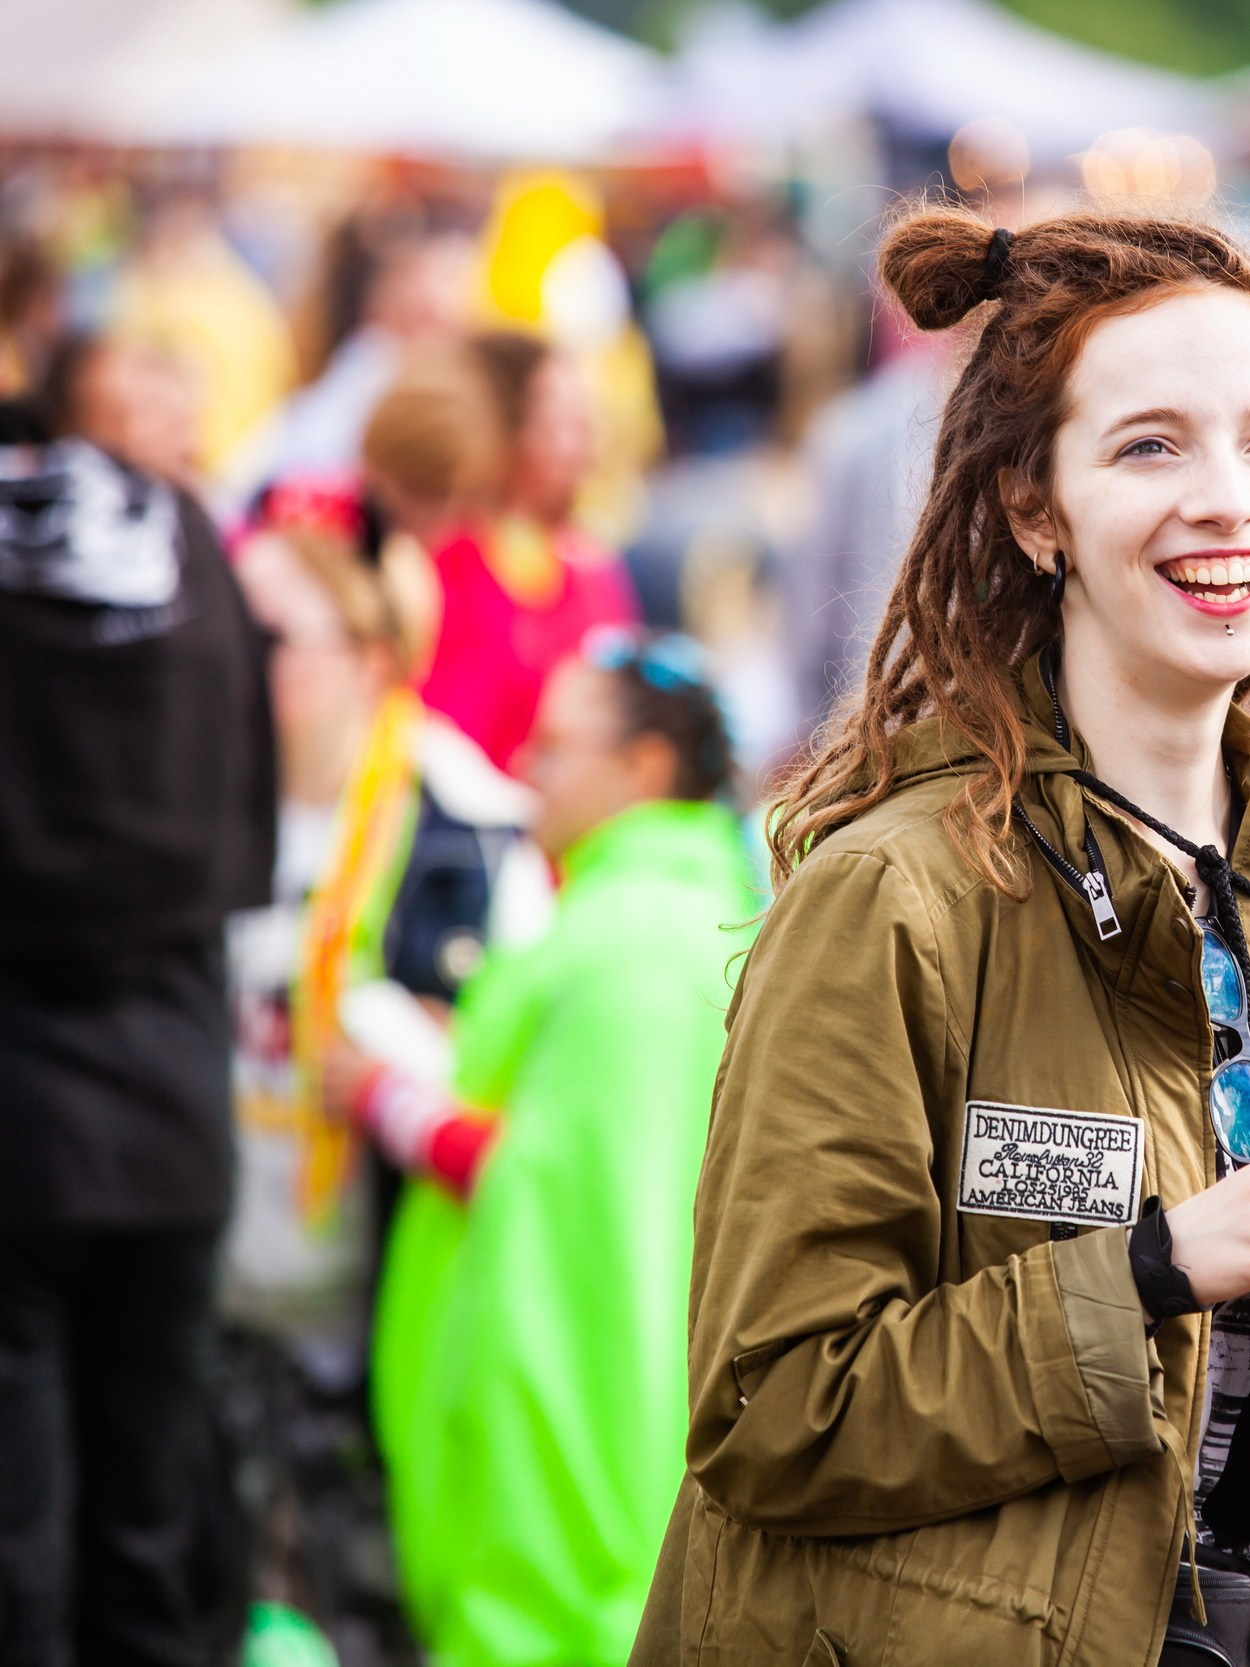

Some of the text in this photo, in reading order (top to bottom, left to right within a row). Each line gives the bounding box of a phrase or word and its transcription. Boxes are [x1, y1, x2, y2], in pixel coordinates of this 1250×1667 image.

[973, 1114, 1132, 1152] DENIMDUNGREE
[979, 1159, 1119, 1190] CALIFORNIA
[967, 1188, 1125, 1218] AMERICAN JEANS
